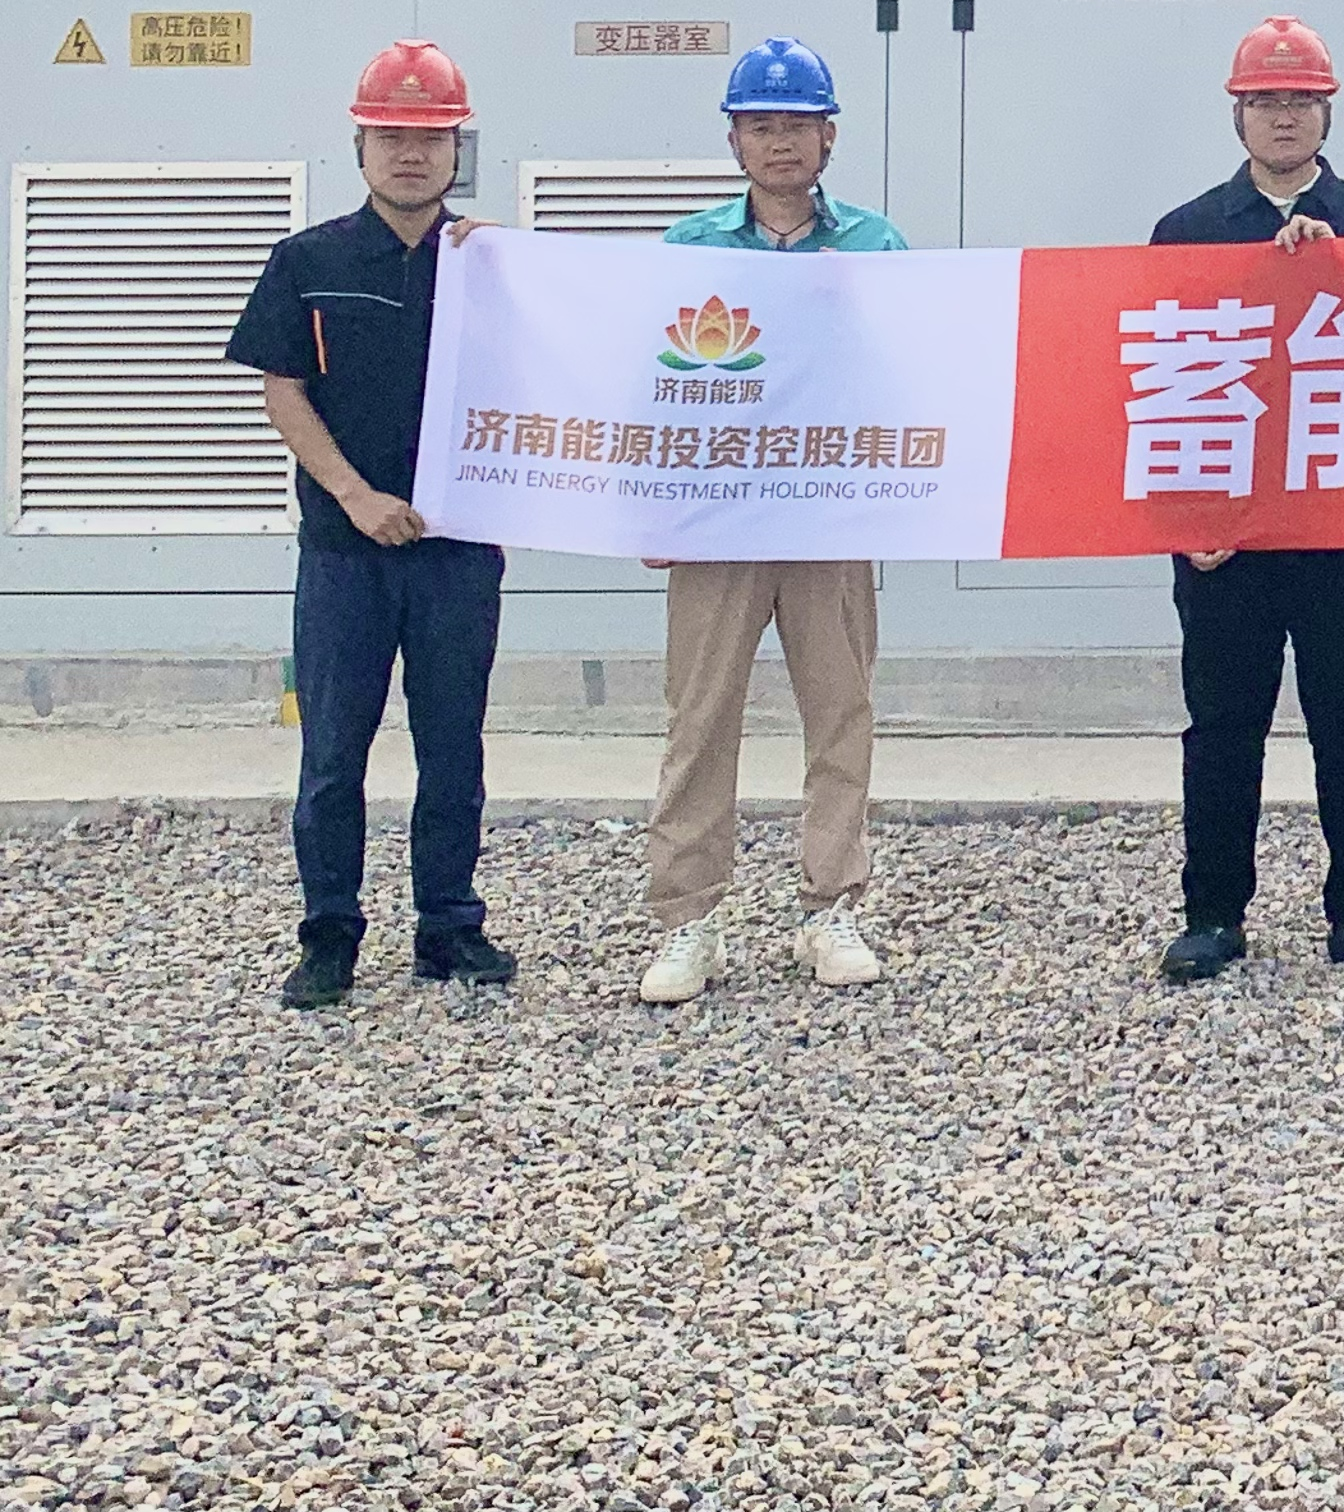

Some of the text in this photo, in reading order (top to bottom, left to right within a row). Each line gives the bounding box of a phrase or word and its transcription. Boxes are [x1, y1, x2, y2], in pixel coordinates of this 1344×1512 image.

[595, 24, 711, 52] 变压器室
[653, 377, 765, 405] 济南能源
[461, 407, 946, 470] 济南能源投资控股集团
[455, 464, 939, 501] JINAN ENERGY INVESTMENT HOLDING GROUP
